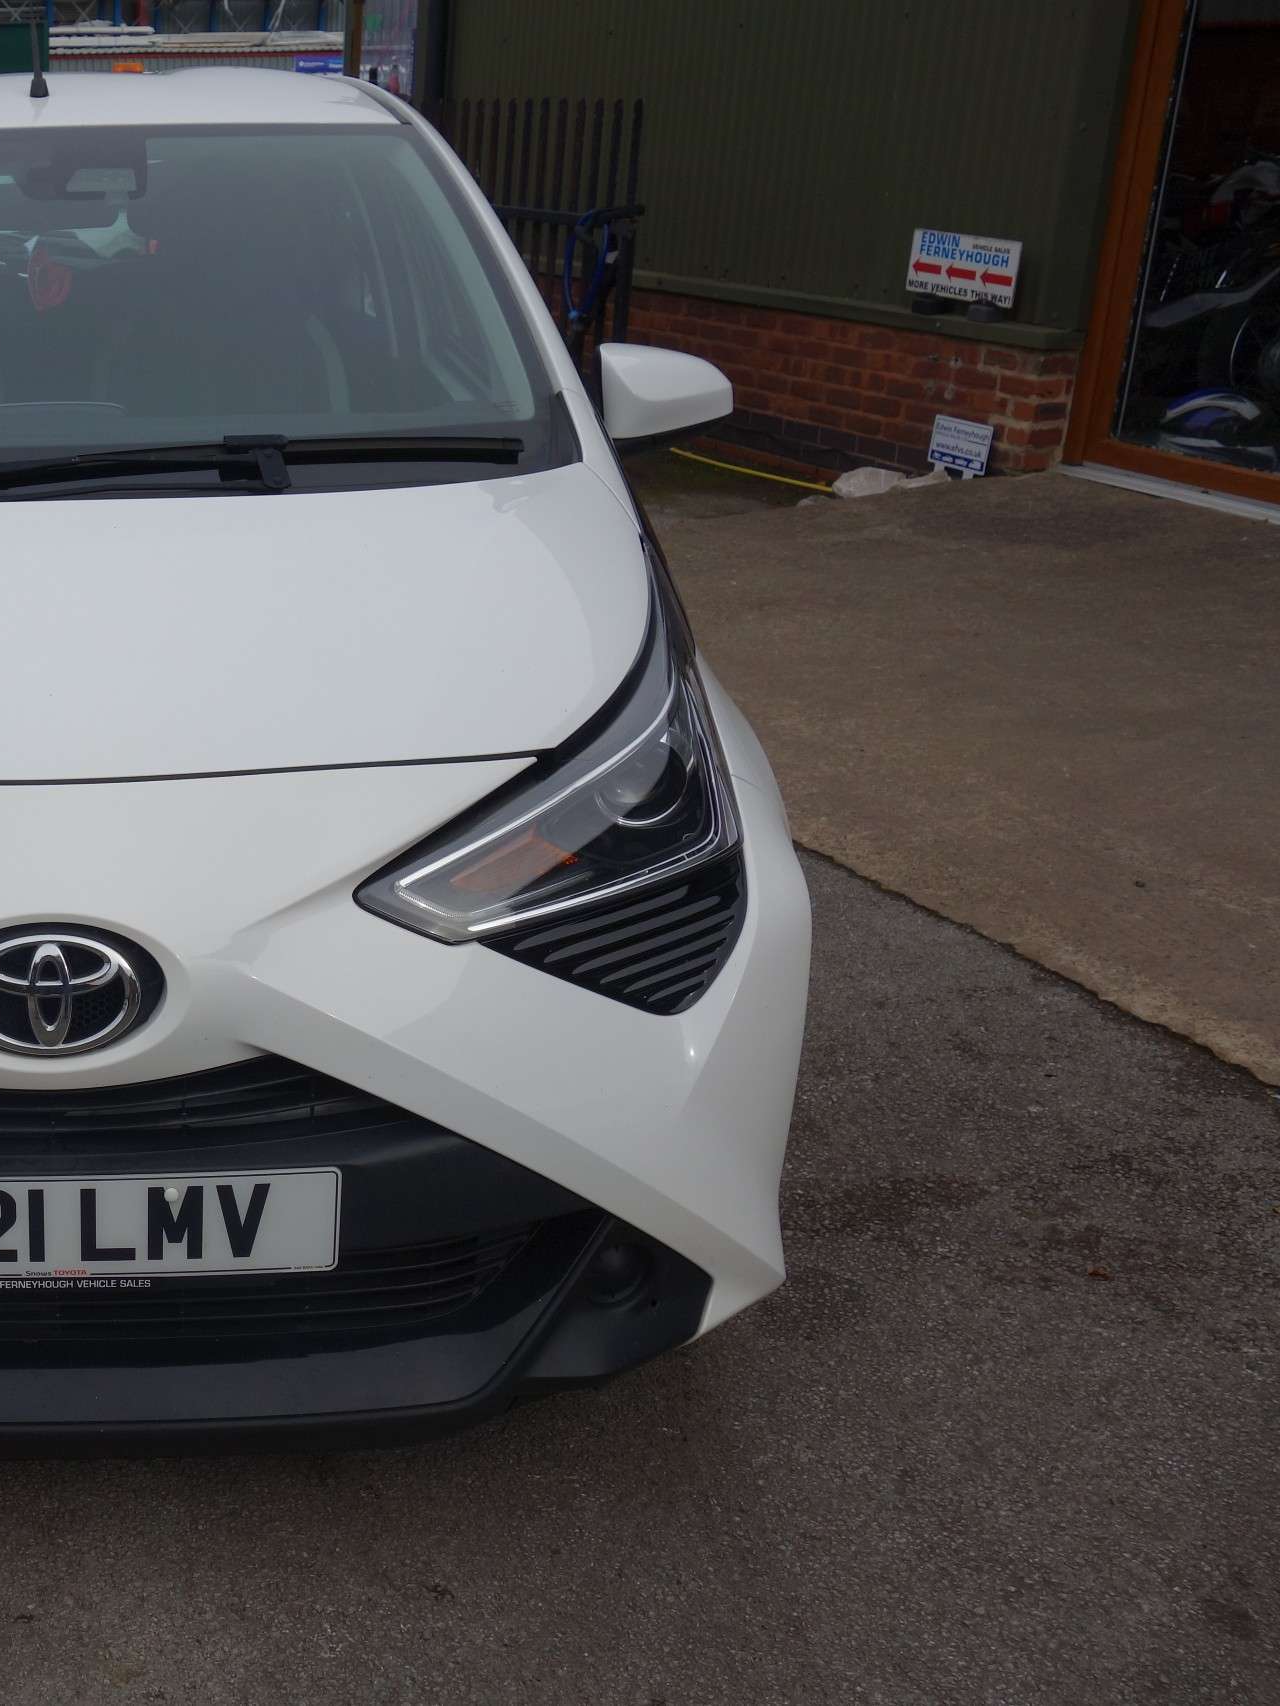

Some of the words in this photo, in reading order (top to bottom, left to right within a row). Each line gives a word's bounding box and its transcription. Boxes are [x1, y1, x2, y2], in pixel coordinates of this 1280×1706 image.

[921, 231, 961, 248] EDWIN
[920, 243, 1010, 268] FERNEYHOUGH
[908, 279, 929, 290] MORE
[931, 283, 969, 297] VEHICLES
[970, 289, 989, 301] THIS
[990, 293, 1012, 305] WAY!
[936, 422, 954, 431] Edwin
[79, 1183, 271, 1262] LMV
[0, 1280, 74, 1289] FERNEYHOUGH
[76, 1279, 117, 1288] VEHICLE
[119, 1279, 151, 1288] SALES
